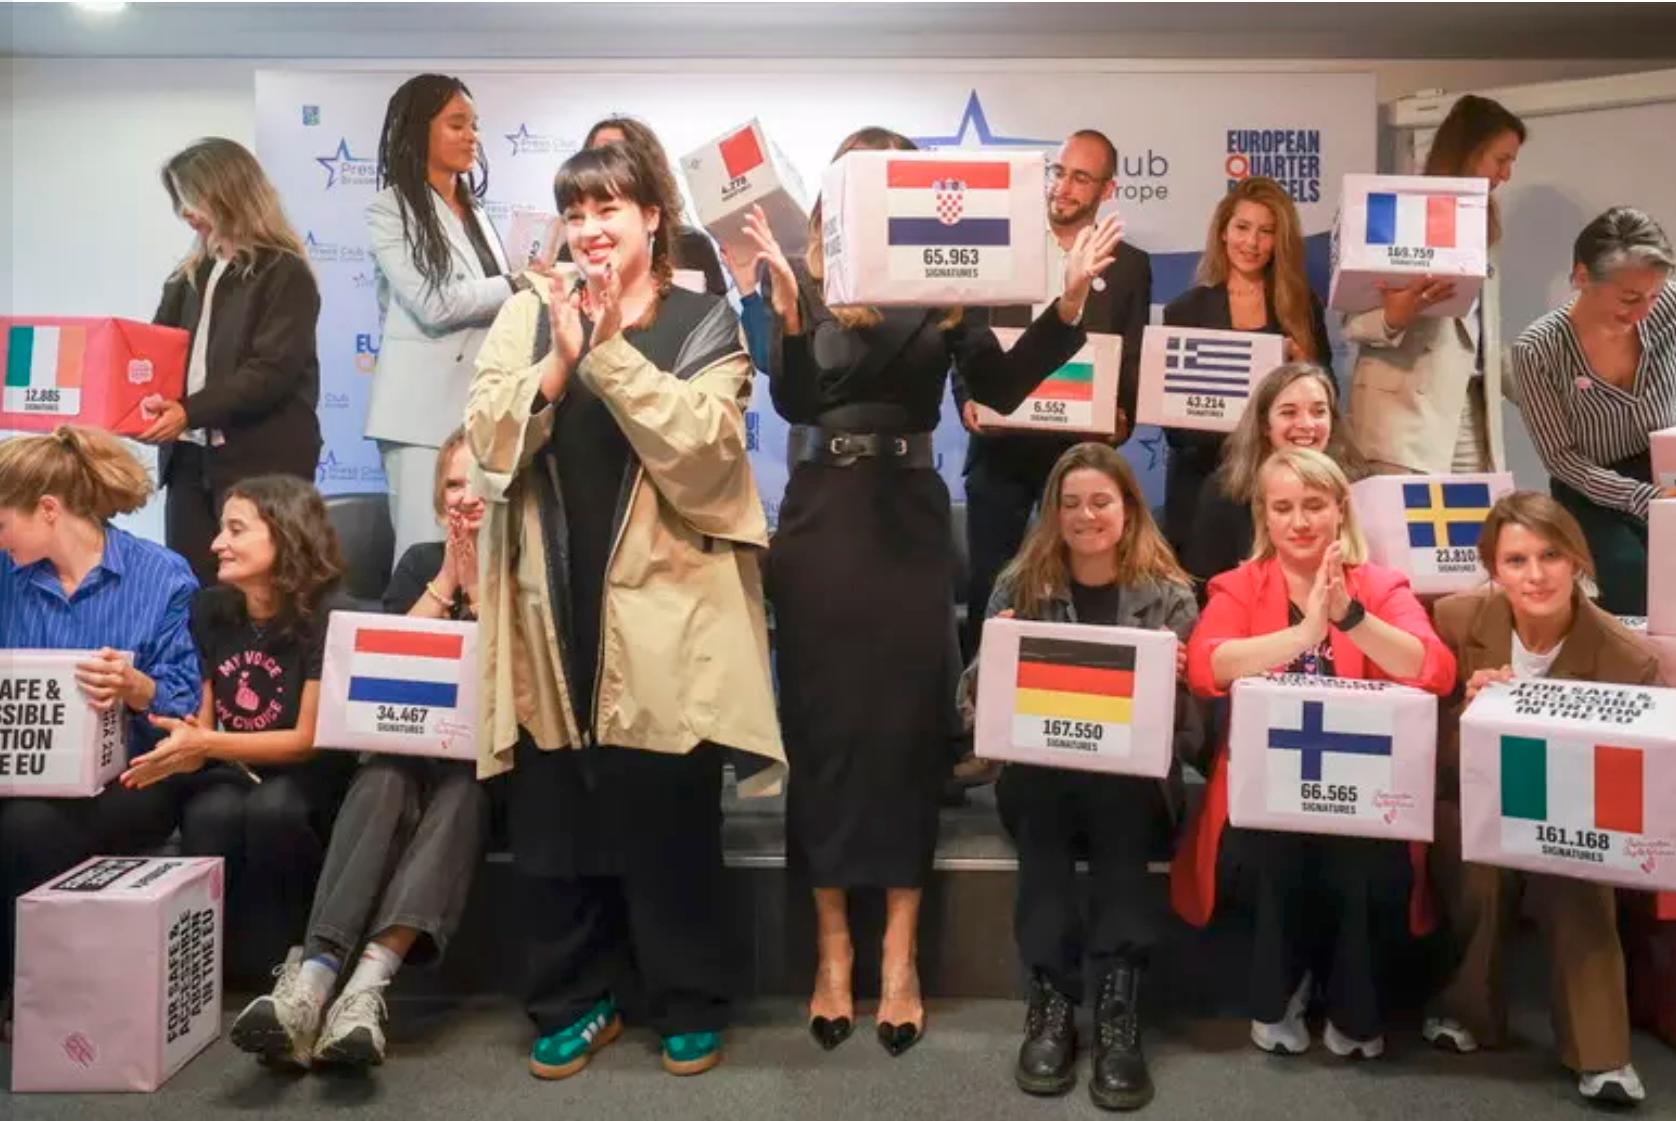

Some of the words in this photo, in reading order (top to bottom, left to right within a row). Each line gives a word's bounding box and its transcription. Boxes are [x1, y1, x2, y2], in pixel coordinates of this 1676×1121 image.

[1227, 130, 1319, 153] EUROPEAN
[1225, 154, 1319, 178] QUARTER
[923, 248, 979, 265] 65.963
[925, 267, 979, 278] SIGNATURES
[1034, 401, 1066, 415] 6.552
[45, 678, 60, 700] &
[376, 705, 428, 723] 34.467
[377, 722, 425, 734] SIGNATURES
[1043, 719, 1103, 740] 167.550
[1046, 737, 1098, 752] SIGNATURES
[15, 752, 45, 775] EU
[1301, 783, 1358, 802] 66.565
[1301, 802, 1356, 814] SIGNATURES
[1535, 825, 1610, 850] 161.168
[1541, 844, 1604, 862] SIGNATURES
[202, 908, 214, 937] EU
[168, 941, 179, 998] SAFE
[202, 937, 214, 981] THE
[202, 980, 214, 1006] IN
[168, 999, 178, 1043] FOR
